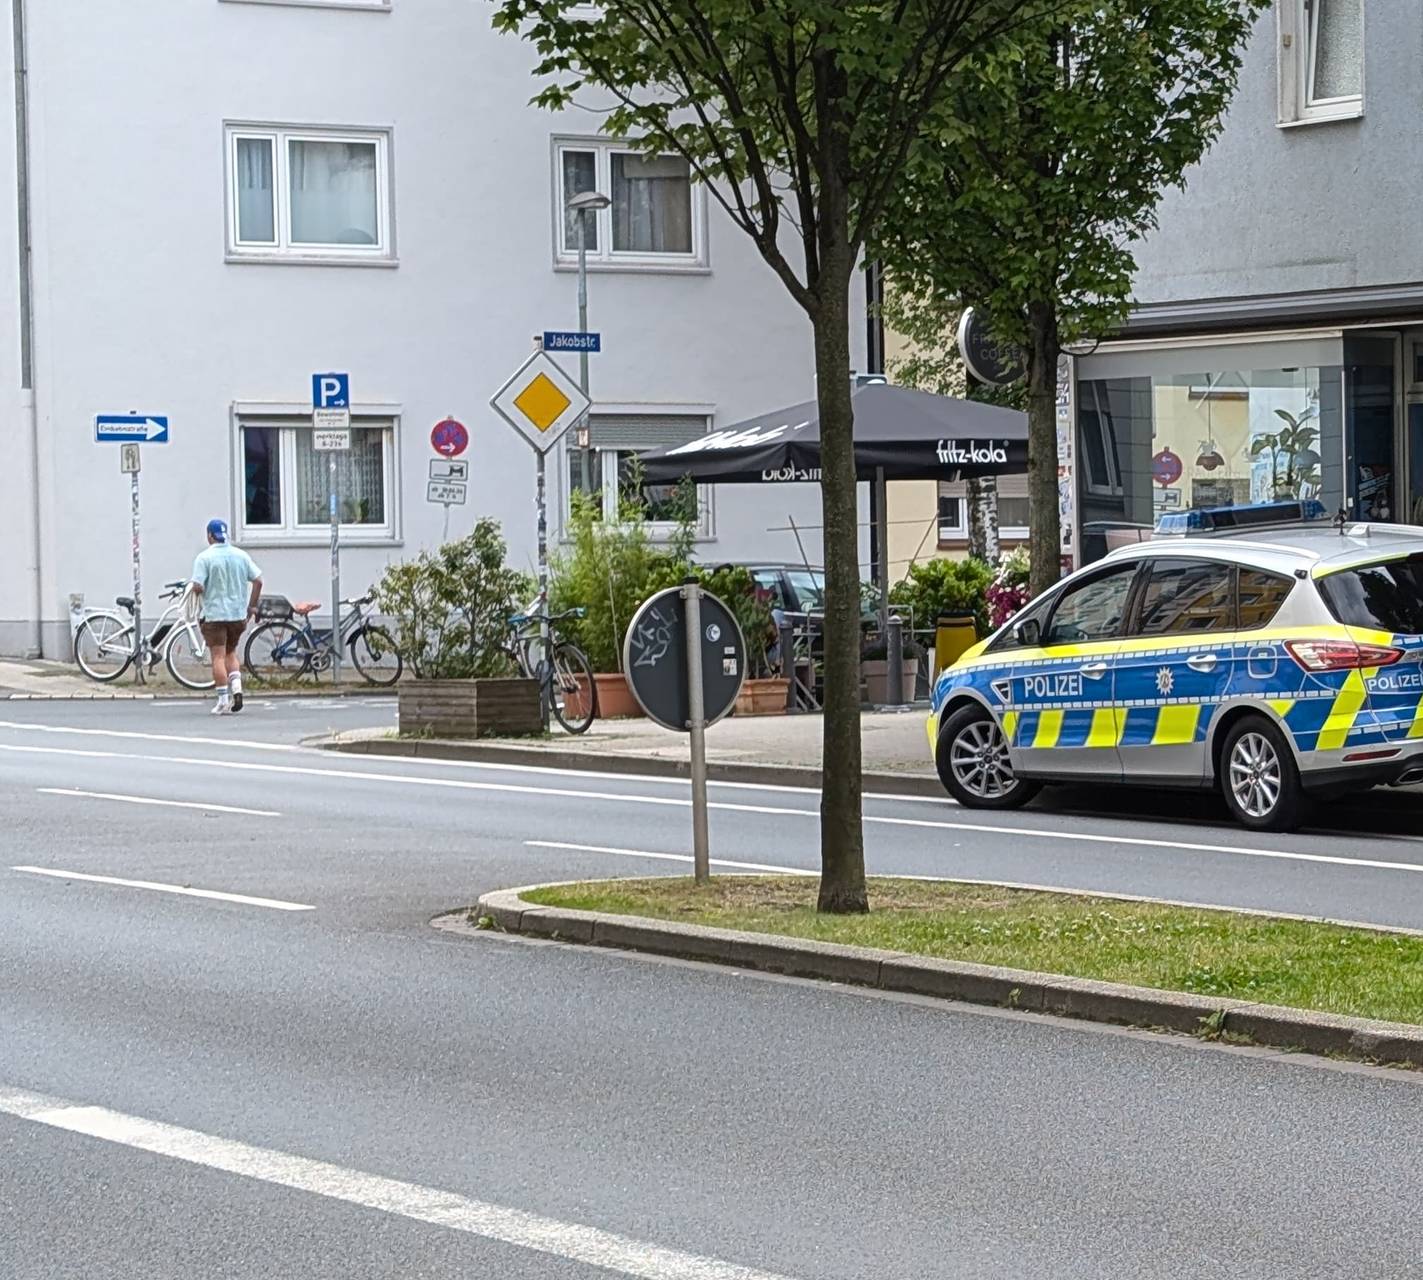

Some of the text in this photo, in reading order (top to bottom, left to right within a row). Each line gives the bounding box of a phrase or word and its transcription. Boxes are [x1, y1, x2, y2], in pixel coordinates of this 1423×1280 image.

[550, 334, 597, 348] Jakobstr.
[321, 378, 341, 407] P
[936, 440, 1007, 463] fritz-kola
[1024, 674, 1083, 698] POLIZEI
[1368, 673, 1423, 691] POLIZEI
